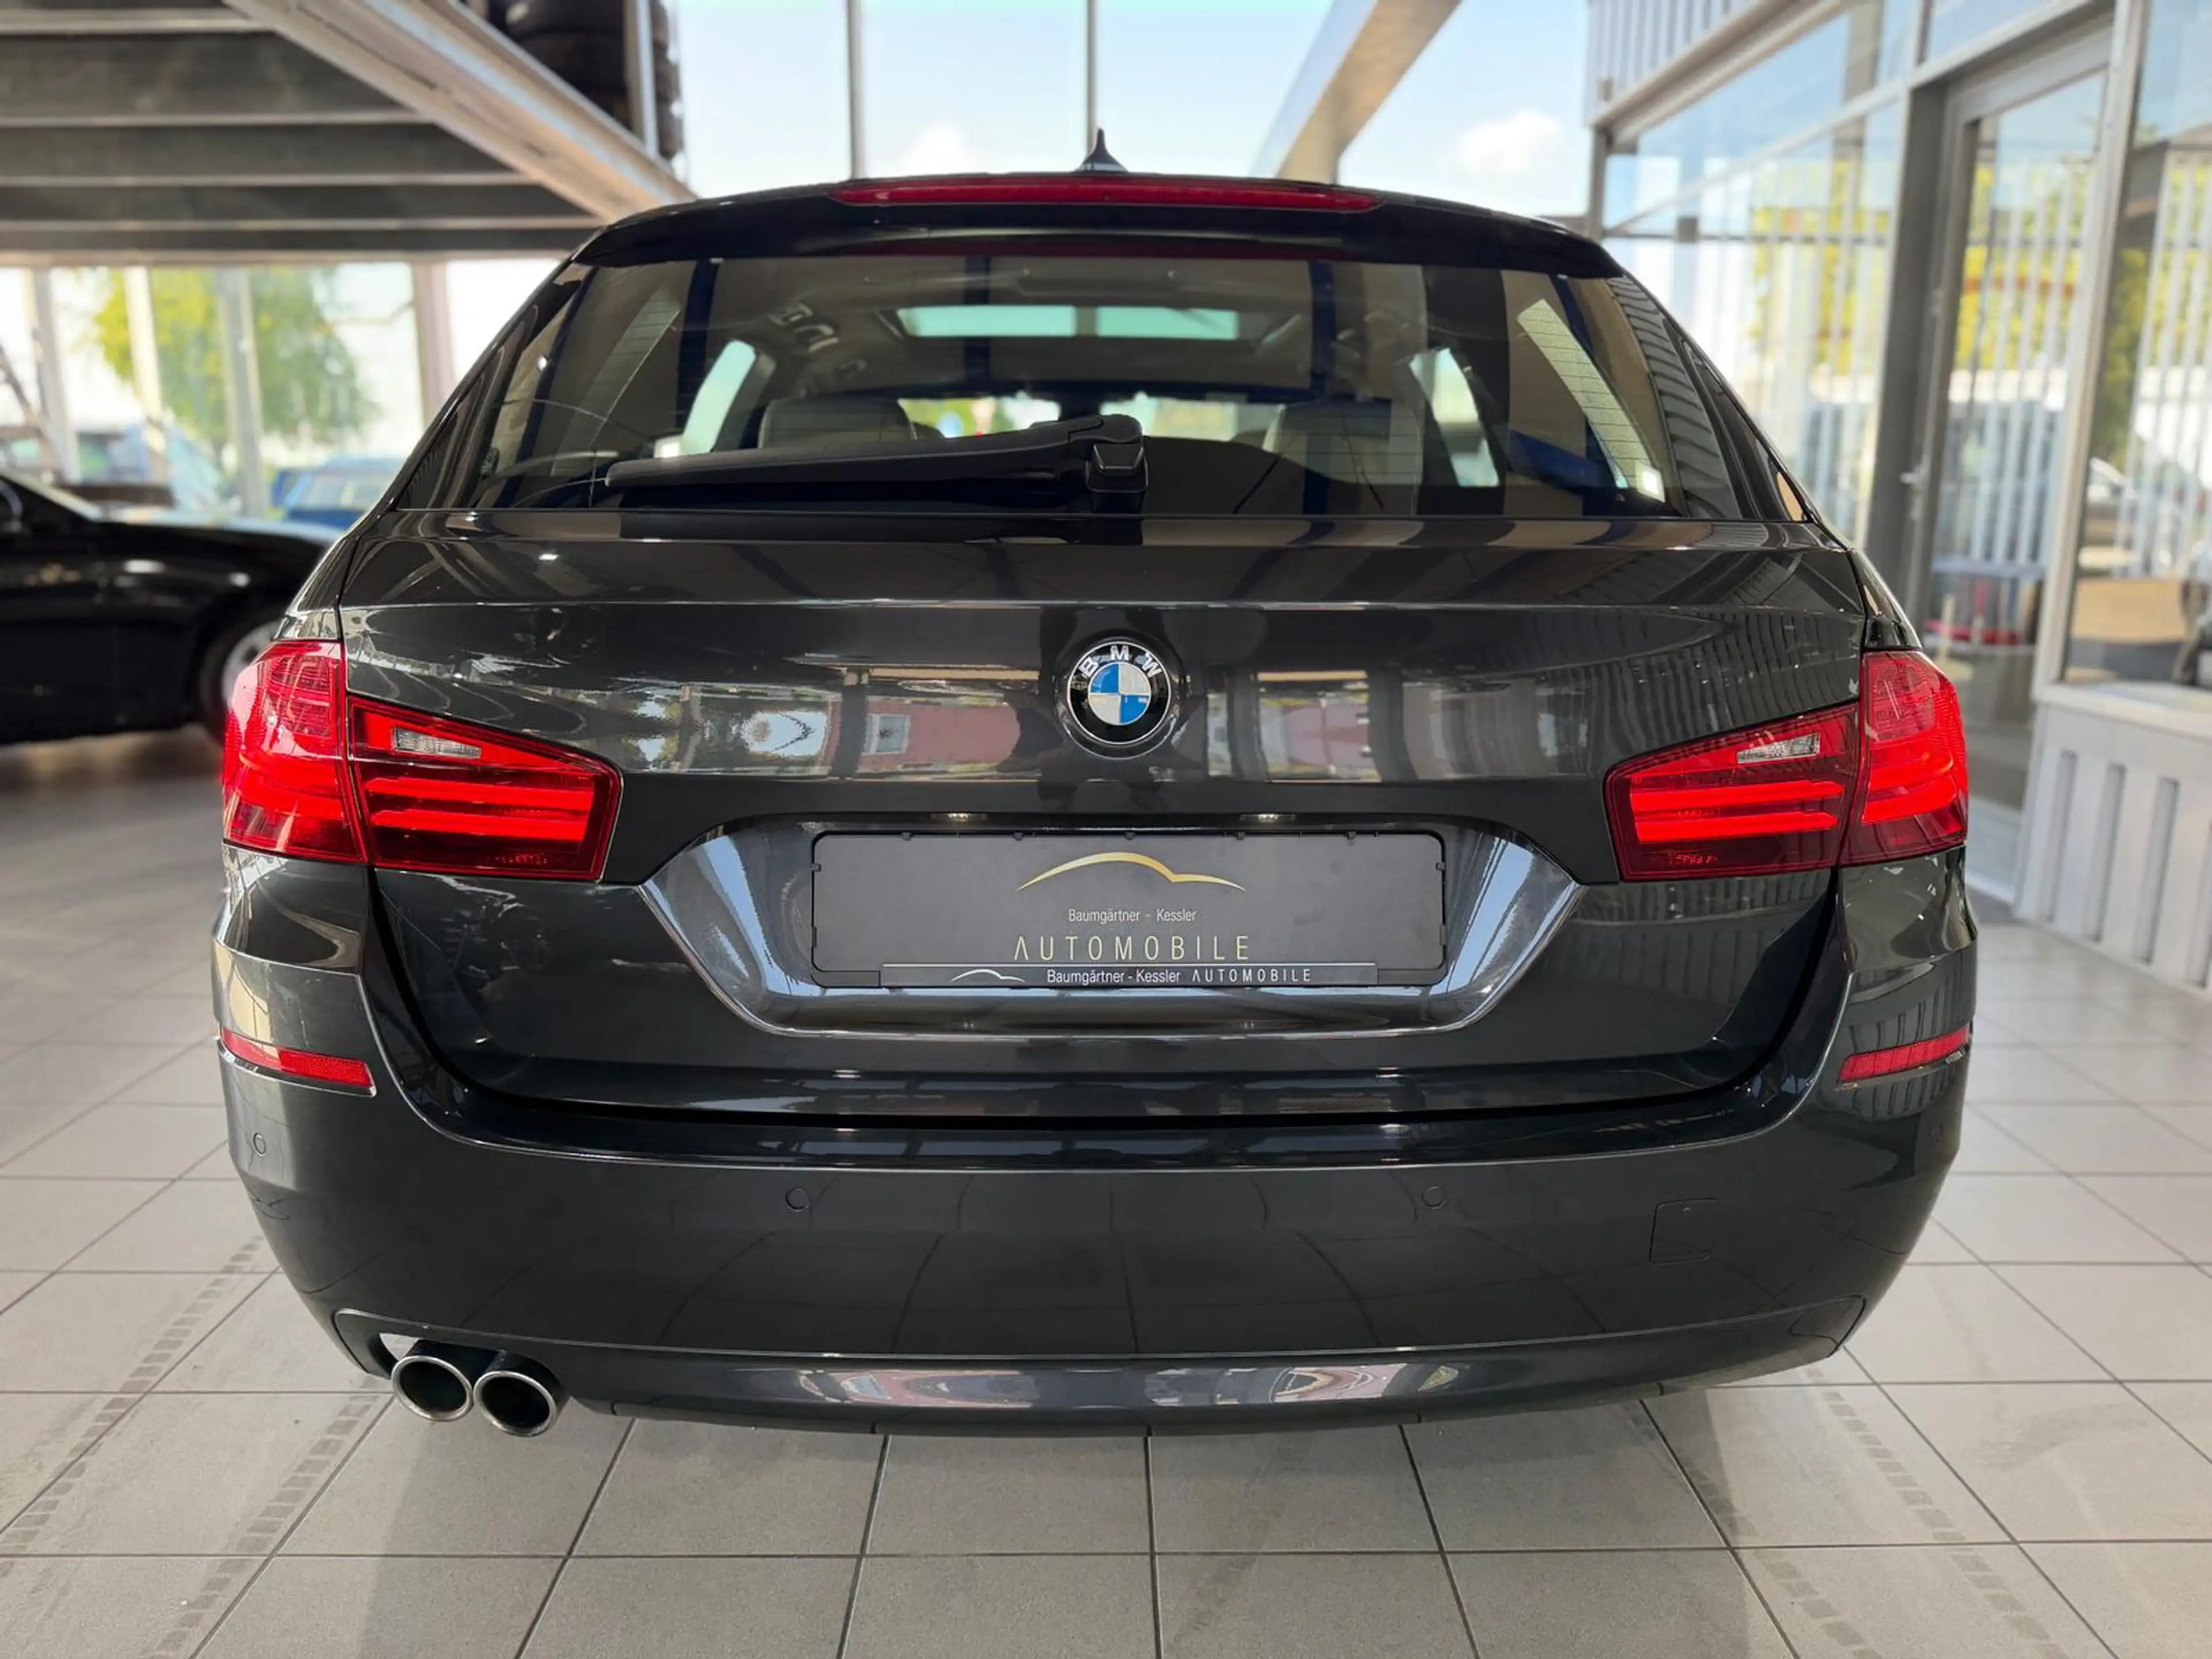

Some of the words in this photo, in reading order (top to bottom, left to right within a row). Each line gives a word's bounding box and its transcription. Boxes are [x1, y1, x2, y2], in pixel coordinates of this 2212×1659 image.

[1078, 645, 1162, 679] BMW
[1069, 908, 1140, 924] Baumgärtner
[1157, 908, 1197, 922] Kessler
[1014, 935, 1249, 960] AUTOMOBILE
[1047, 969, 1124, 986] Baumgärtner
[1136, 968, 1180, 983] Kessler
[1192, 968, 1311, 983] AUTOMOBILE
